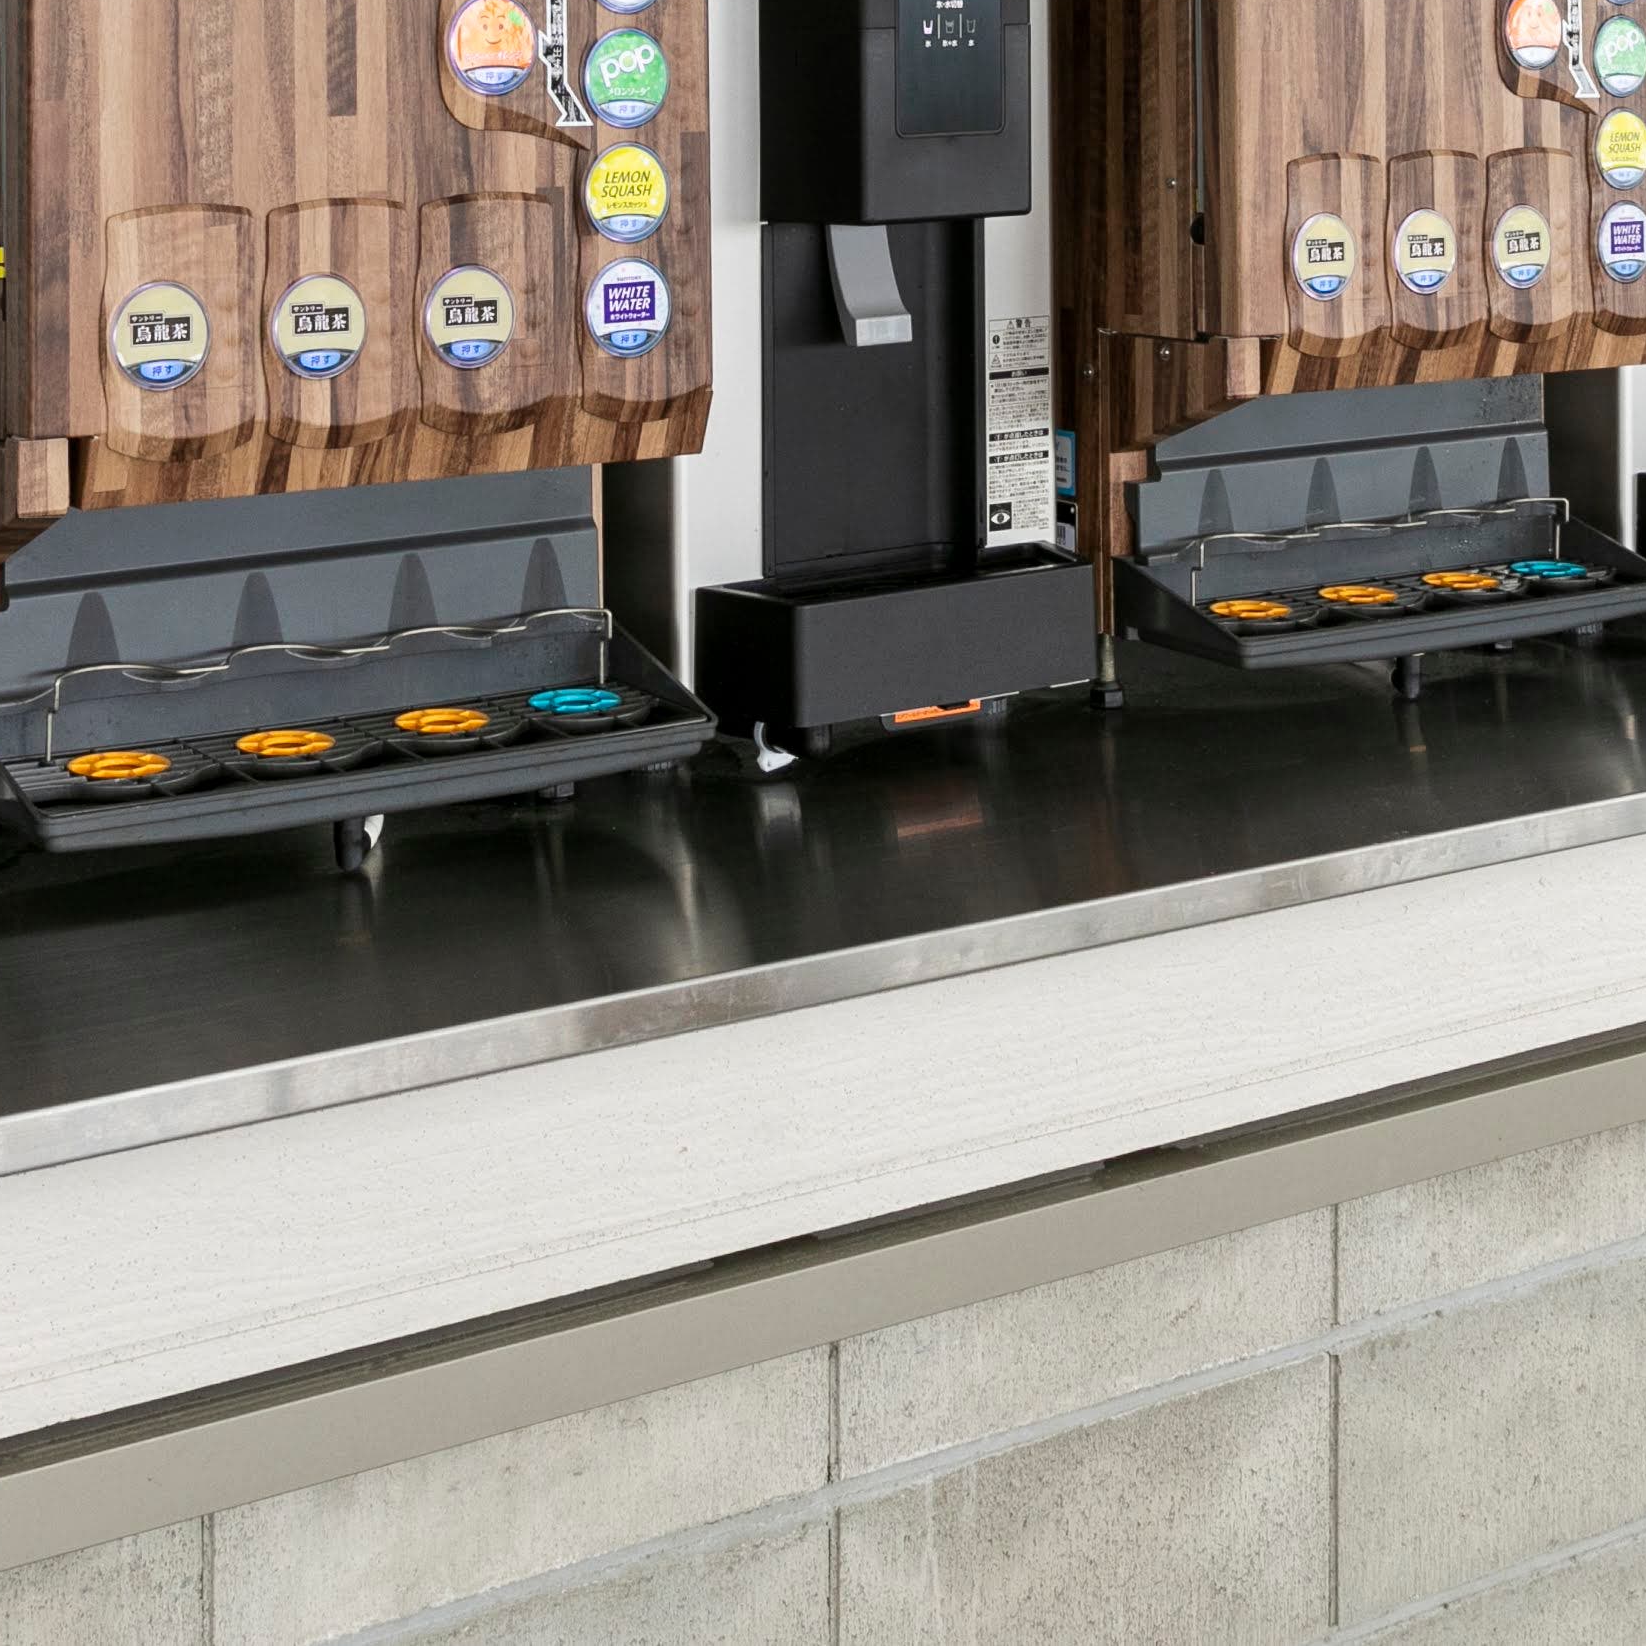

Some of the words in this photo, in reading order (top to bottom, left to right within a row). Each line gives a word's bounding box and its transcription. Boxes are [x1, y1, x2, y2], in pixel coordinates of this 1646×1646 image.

[1603, 27, 1641, 64] pop
[600, 44, 655, 88] pop
[608, 87, 651, 96] メロンソーダ
[1610, 132, 1640, 143] LEMON
[1608, 143, 1641, 154] SQUASH
[604, 170, 651, 184] LEMON
[601, 184, 652, 198] SQUASH
[1612, 224, 1642, 236] WHITE
[1613, 234, 1642, 246] WATER
[608, 285, 651, 300] WHITE
[443, 297, 473, 306] サントリー
[609, 298, 651, 312] WATER
[292, 304, 323, 313] サントリー
[131, 315, 162, 323] サントリー
[460, 343, 482, 357] 押す
[311, 353, 332, 366] 押す
[152, 364, 173, 377] 押す
